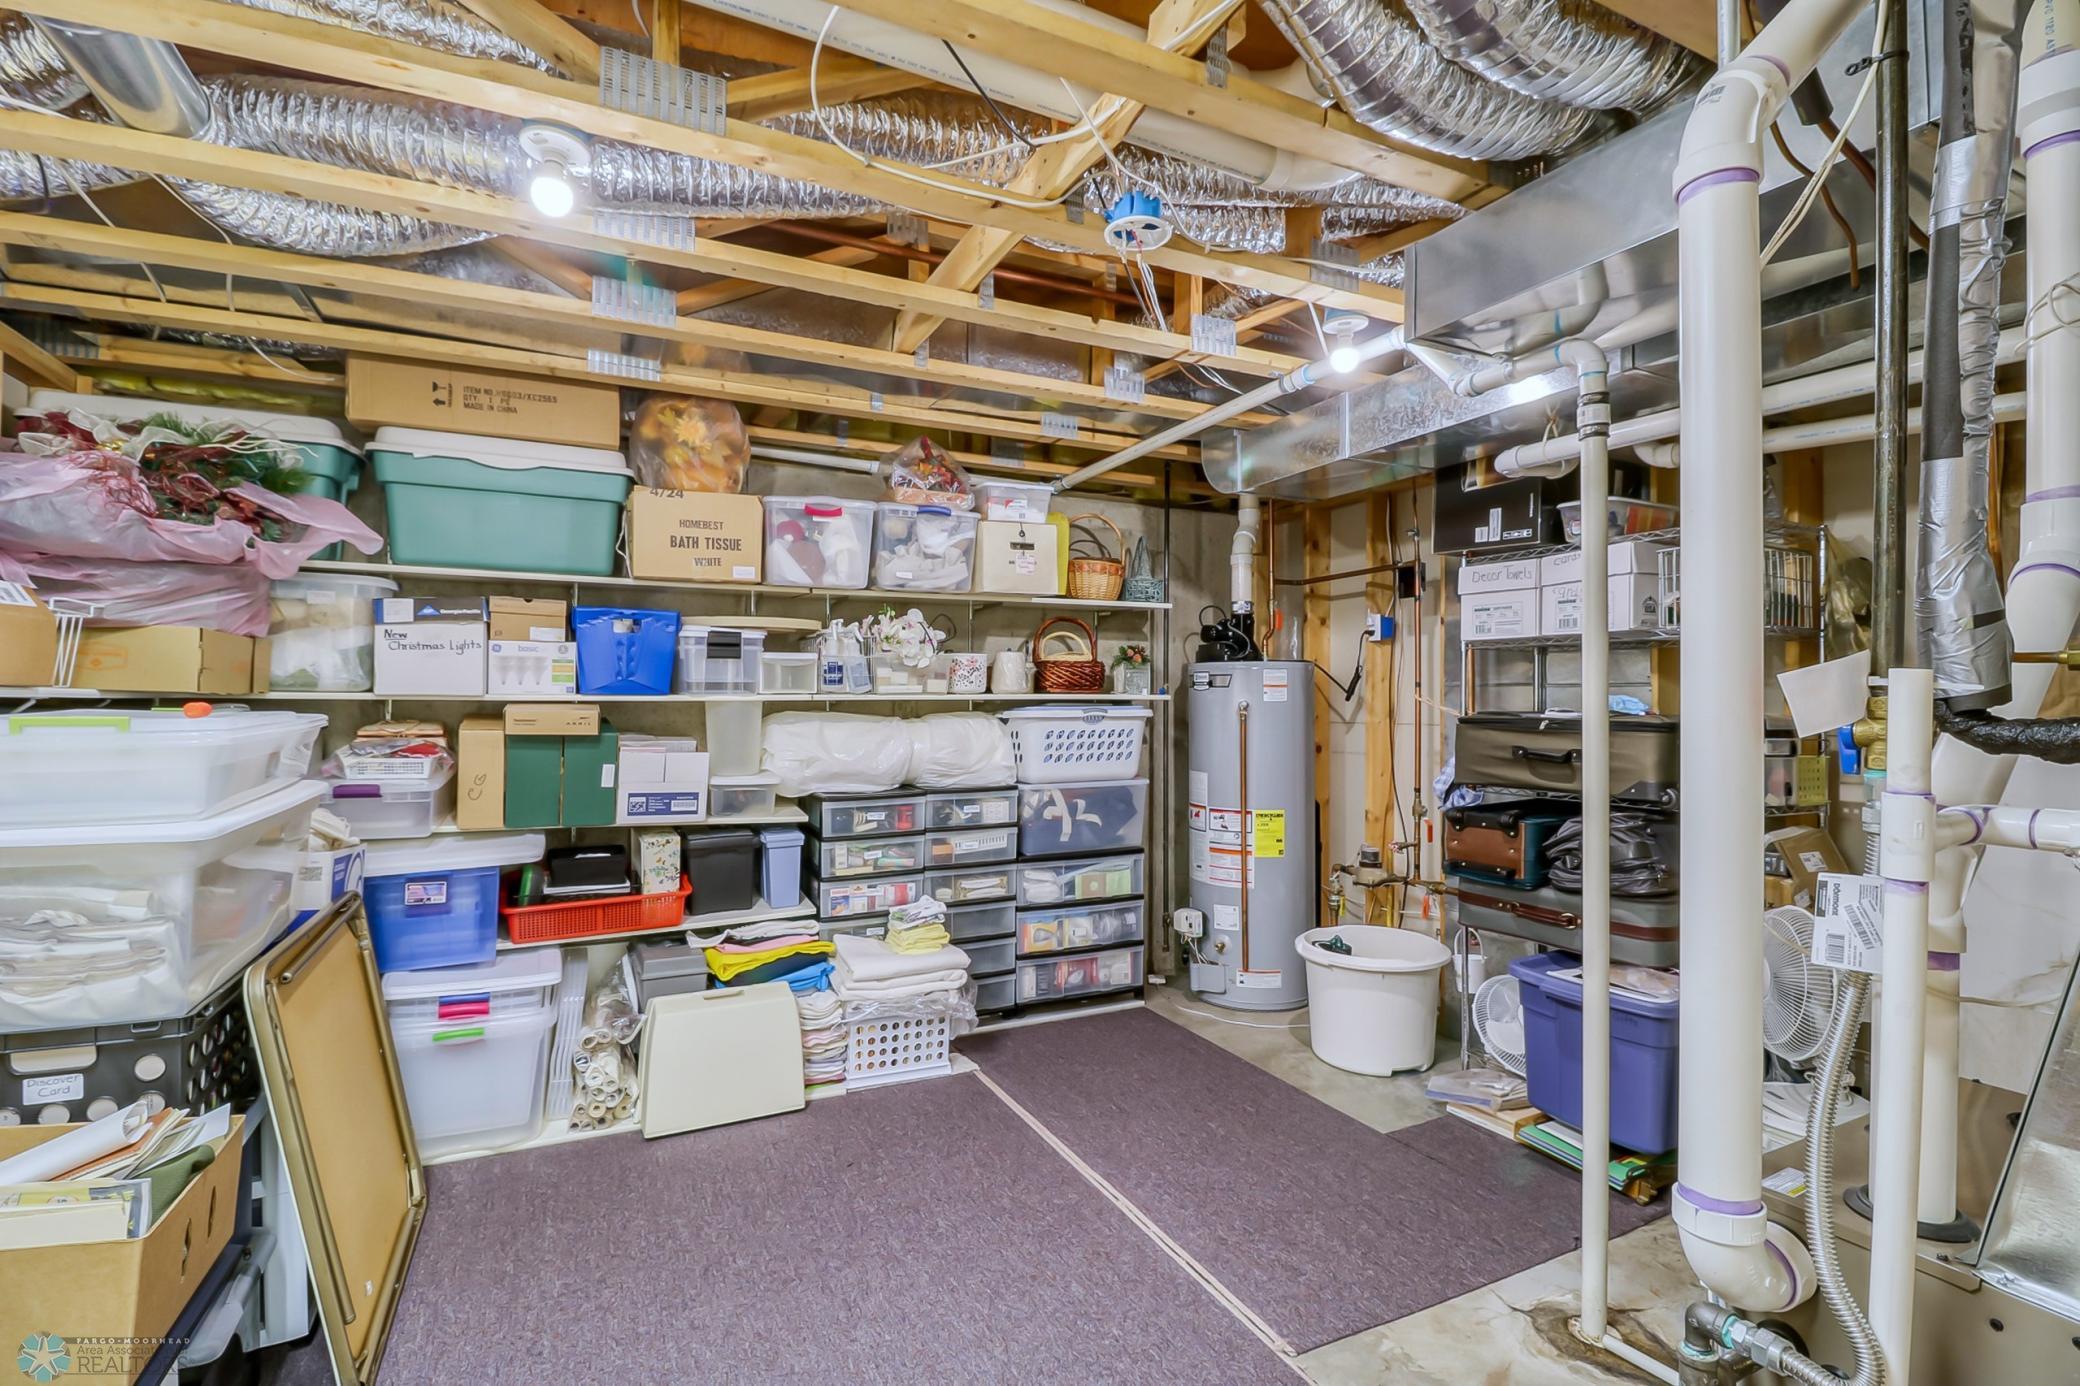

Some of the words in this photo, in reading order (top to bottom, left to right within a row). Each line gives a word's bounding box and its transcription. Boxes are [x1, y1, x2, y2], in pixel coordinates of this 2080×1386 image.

[463, 386, 481, 395] ITEM
[463, 402, 484, 411] MADE
[497, 406, 518, 414] CHINA
[679, 519, 724, 530] HOMEBEST
[670, 535, 699, 549] BATH
[704, 537, 742, 551] TISSUE
[694, 557, 722, 567] WHITE
[1472, 571, 1502, 583] Decor
[384, 629, 408, 640] New
[388, 640, 446, 651] Christmas
[27, 1075, 79, 1088] Discover
[38, 1085, 71, 1097] Card
